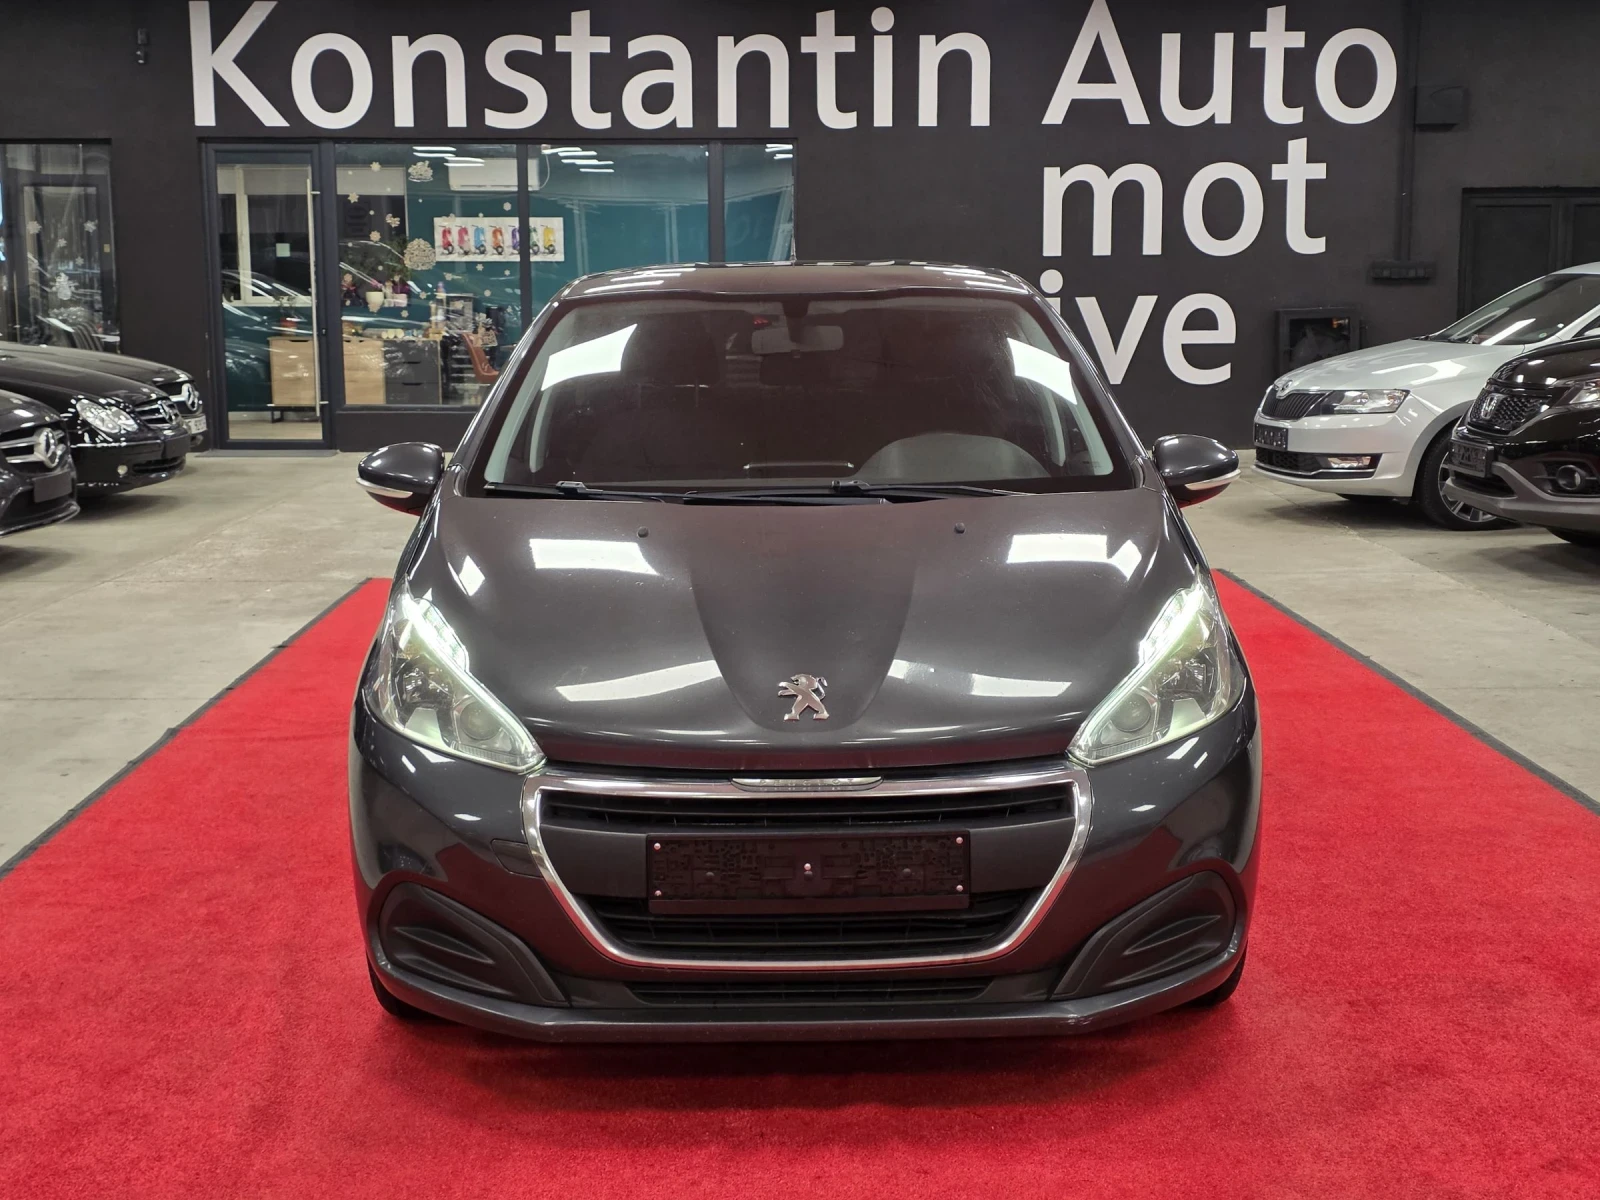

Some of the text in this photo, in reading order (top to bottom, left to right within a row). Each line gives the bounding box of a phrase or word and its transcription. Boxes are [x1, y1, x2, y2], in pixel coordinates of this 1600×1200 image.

[190, 0, 1397, 129] Konstantin Auto
[1042, 138, 1327, 256] mot
